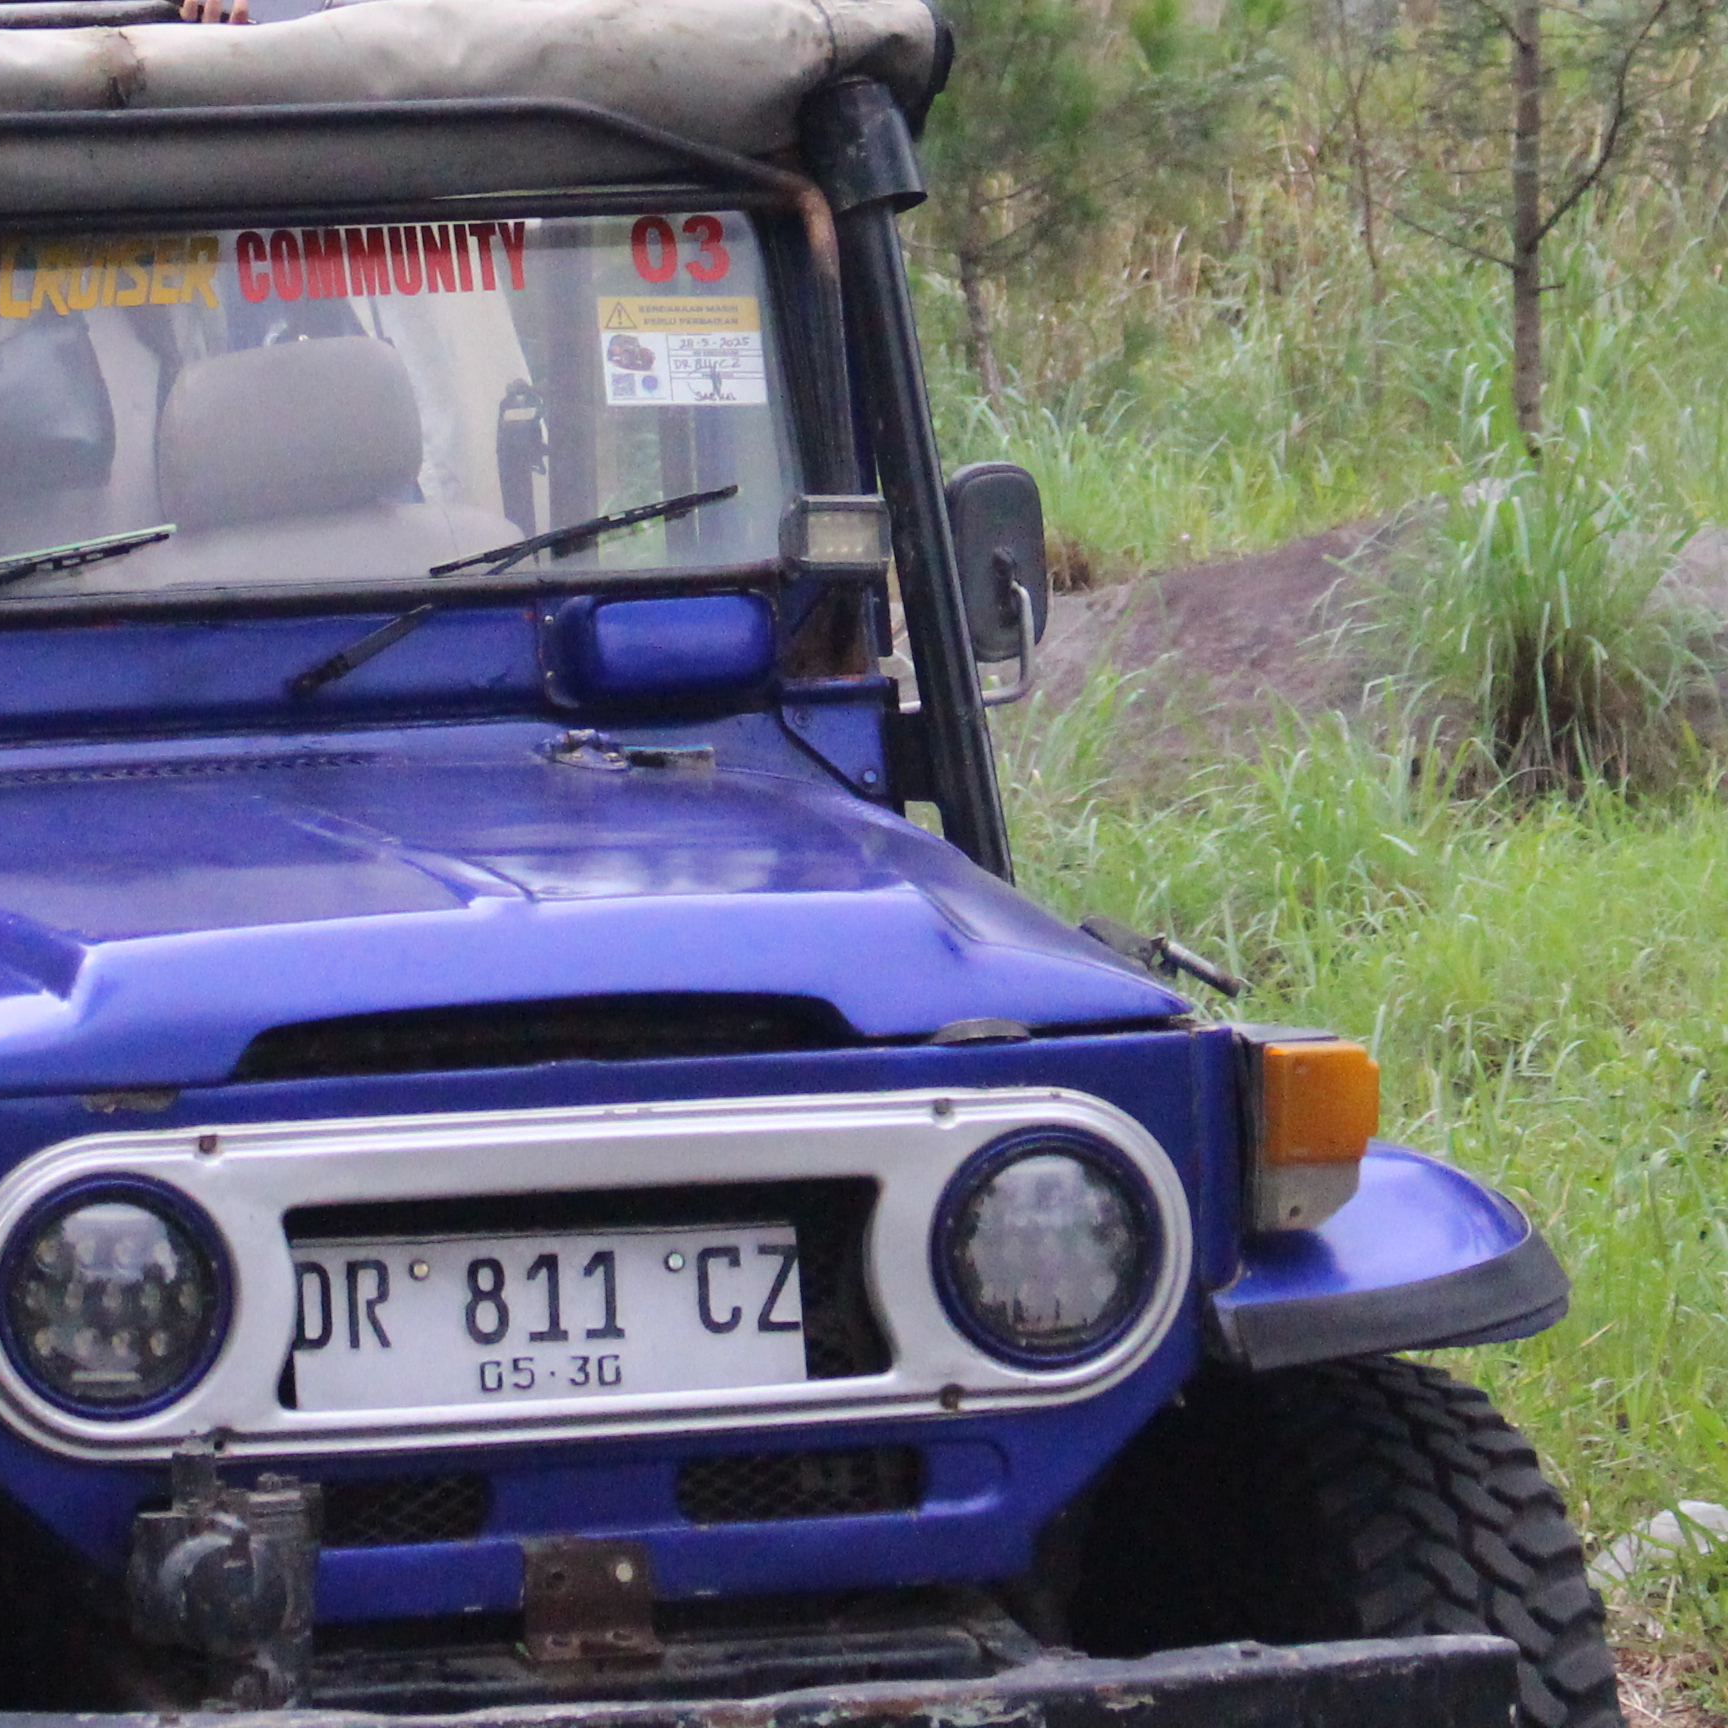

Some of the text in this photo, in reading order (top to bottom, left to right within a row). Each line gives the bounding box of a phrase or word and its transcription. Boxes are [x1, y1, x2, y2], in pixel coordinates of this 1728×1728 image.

[236, 221, 526, 303] COMMUNITY
[631, 215, 731, 282] 03
[295, 1244, 802, 1351] DR 811 CZ
